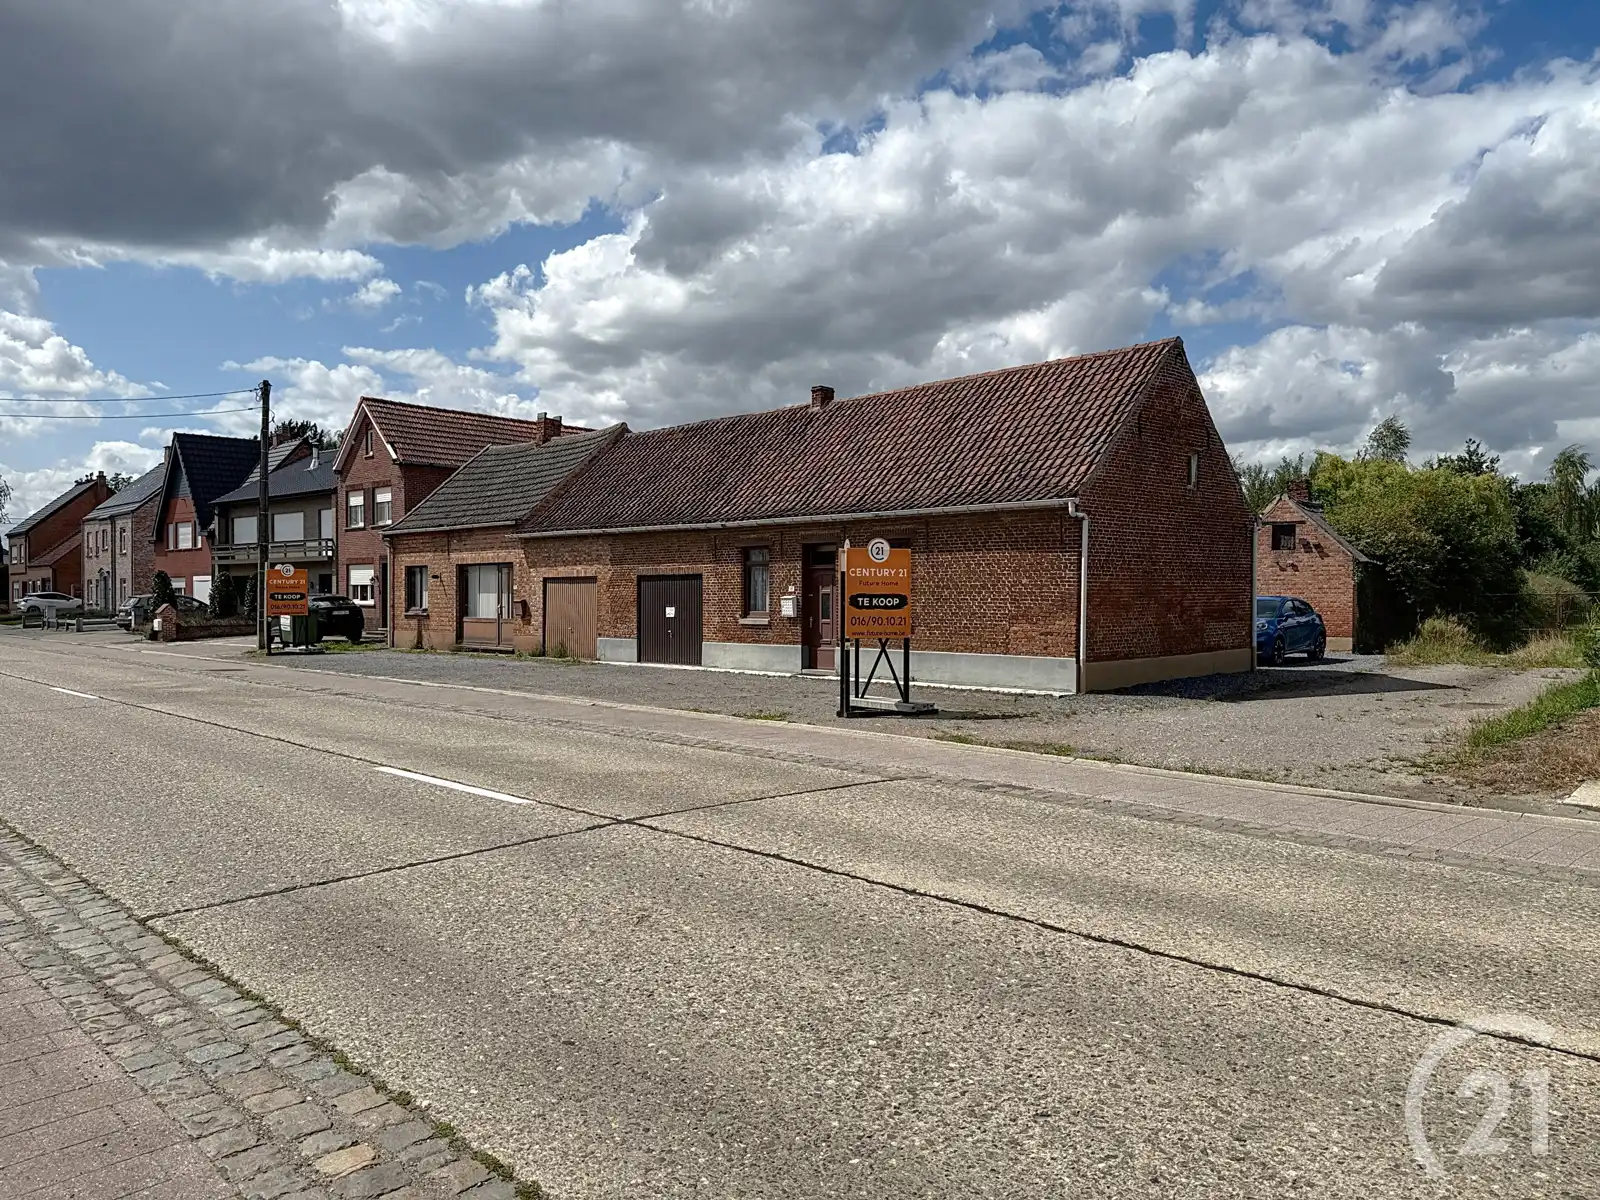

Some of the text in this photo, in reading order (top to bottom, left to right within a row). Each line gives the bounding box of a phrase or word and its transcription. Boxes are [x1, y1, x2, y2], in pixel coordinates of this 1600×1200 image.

[849, 568, 907, 577] CENTURY 21
[857, 598, 900, 606] TE KOOP
[850, 616, 907, 626] 016/90.10.21
